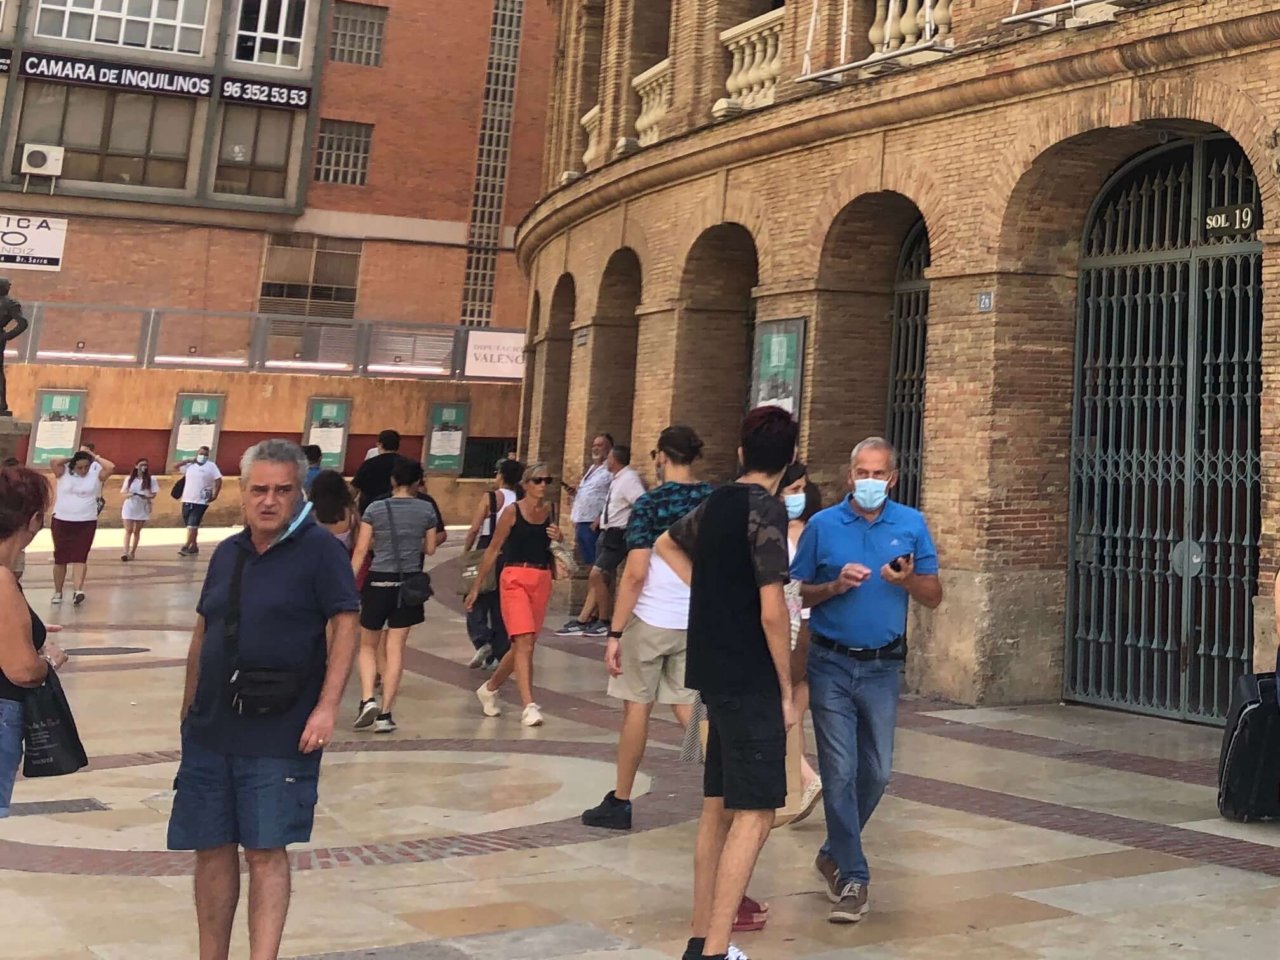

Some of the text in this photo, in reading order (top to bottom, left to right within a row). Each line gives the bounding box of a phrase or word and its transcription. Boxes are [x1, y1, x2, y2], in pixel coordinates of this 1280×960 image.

[25, 56, 96, 82] CAMARA
[99, 67, 118, 84] DE
[121, 68, 210, 95] INQUILINOS
[223, 81, 240, 98] 96
[243, 83, 268, 102] 352
[271, 86, 287, 104] 53
[289, 88, 307, 106] 53
[0, 216, 51, 231] ICA
[1205, 207, 1251, 230] SOL 19
